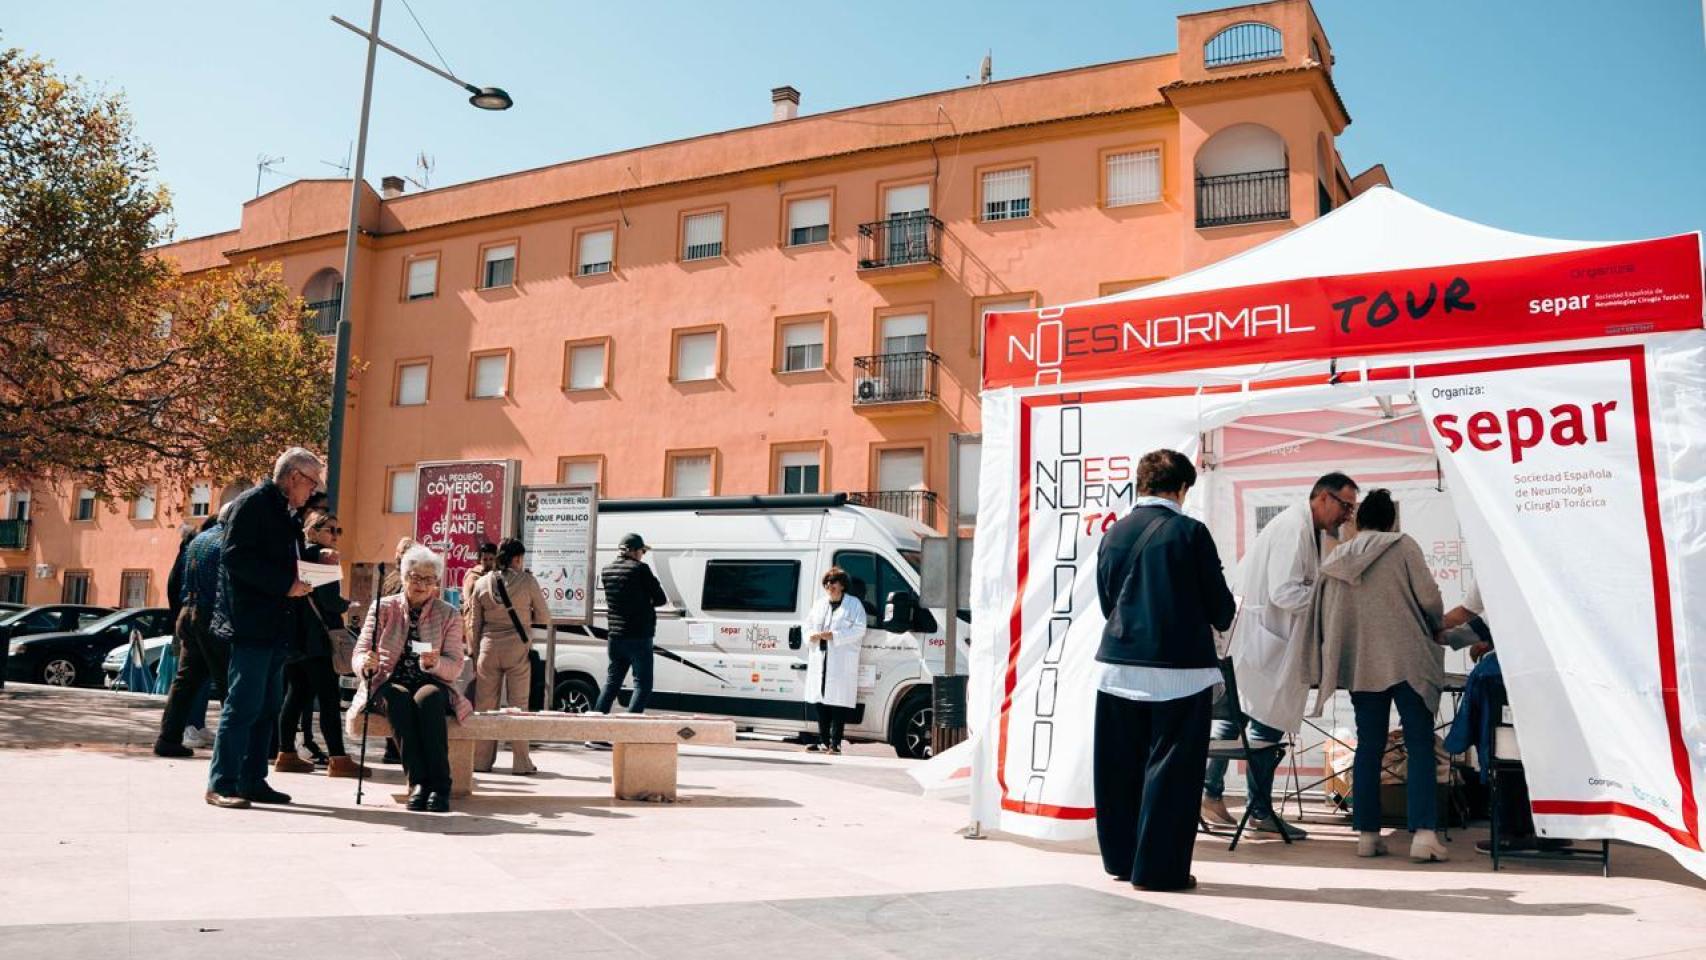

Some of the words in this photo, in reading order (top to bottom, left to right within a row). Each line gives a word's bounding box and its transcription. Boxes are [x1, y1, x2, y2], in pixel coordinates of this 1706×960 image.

[1332, 276, 1476, 334] TOUR
[1529, 293, 1590, 316] separ
[1432, 384, 1486, 400] Organiza:
[1433, 400, 1617, 464] separ
[449, 471, 484, 481] PEQUEÑO
[1513, 472, 1561, 484] Sociedad
[1563, 468, 1612, 482] Española
[427, 480, 494, 495] COMERCIO
[1514, 488, 1528, 498] de
[1531, 483, 1592, 497] Neumología
[452, 493, 467, 511] TÚ
[563, 496, 576, 505] DEL
[577, 495, 589, 505] RÍO
[1516, 503, 1521, 513] y
[1524, 499, 1560, 512] Cirugía
[1561, 497, 1607, 508] Torácica
[452, 512, 477, 521] HACES
[526, 514, 554, 522] PARQUE
[432, 520, 484, 534] GRANDE
[720, 627, 741, 635] separ
[928, 638, 945, 647] sep
